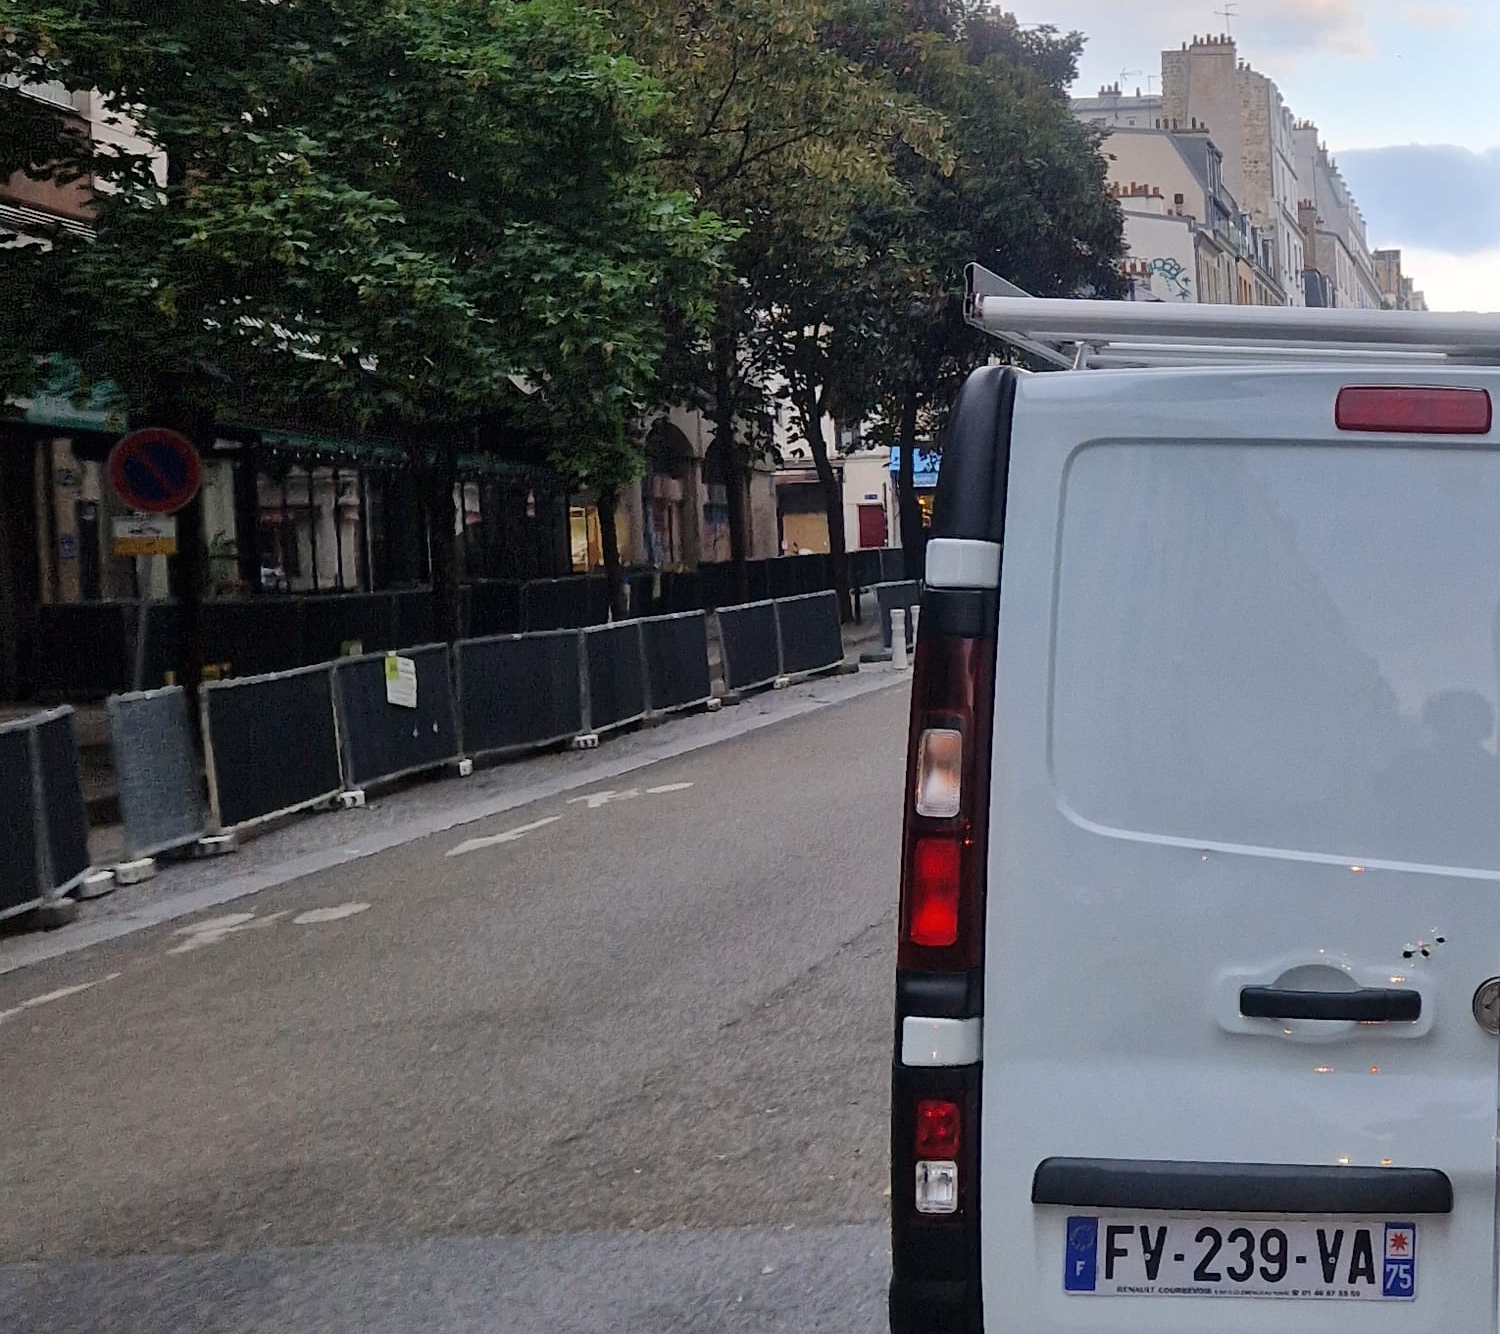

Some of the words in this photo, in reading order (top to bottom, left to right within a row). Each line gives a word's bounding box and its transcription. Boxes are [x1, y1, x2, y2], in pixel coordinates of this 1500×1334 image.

[1075, 1259, 1087, 1277] F
[1105, 1225, 1376, 1284] FV-239-VA
[1385, 1263, 1413, 1290] 75
